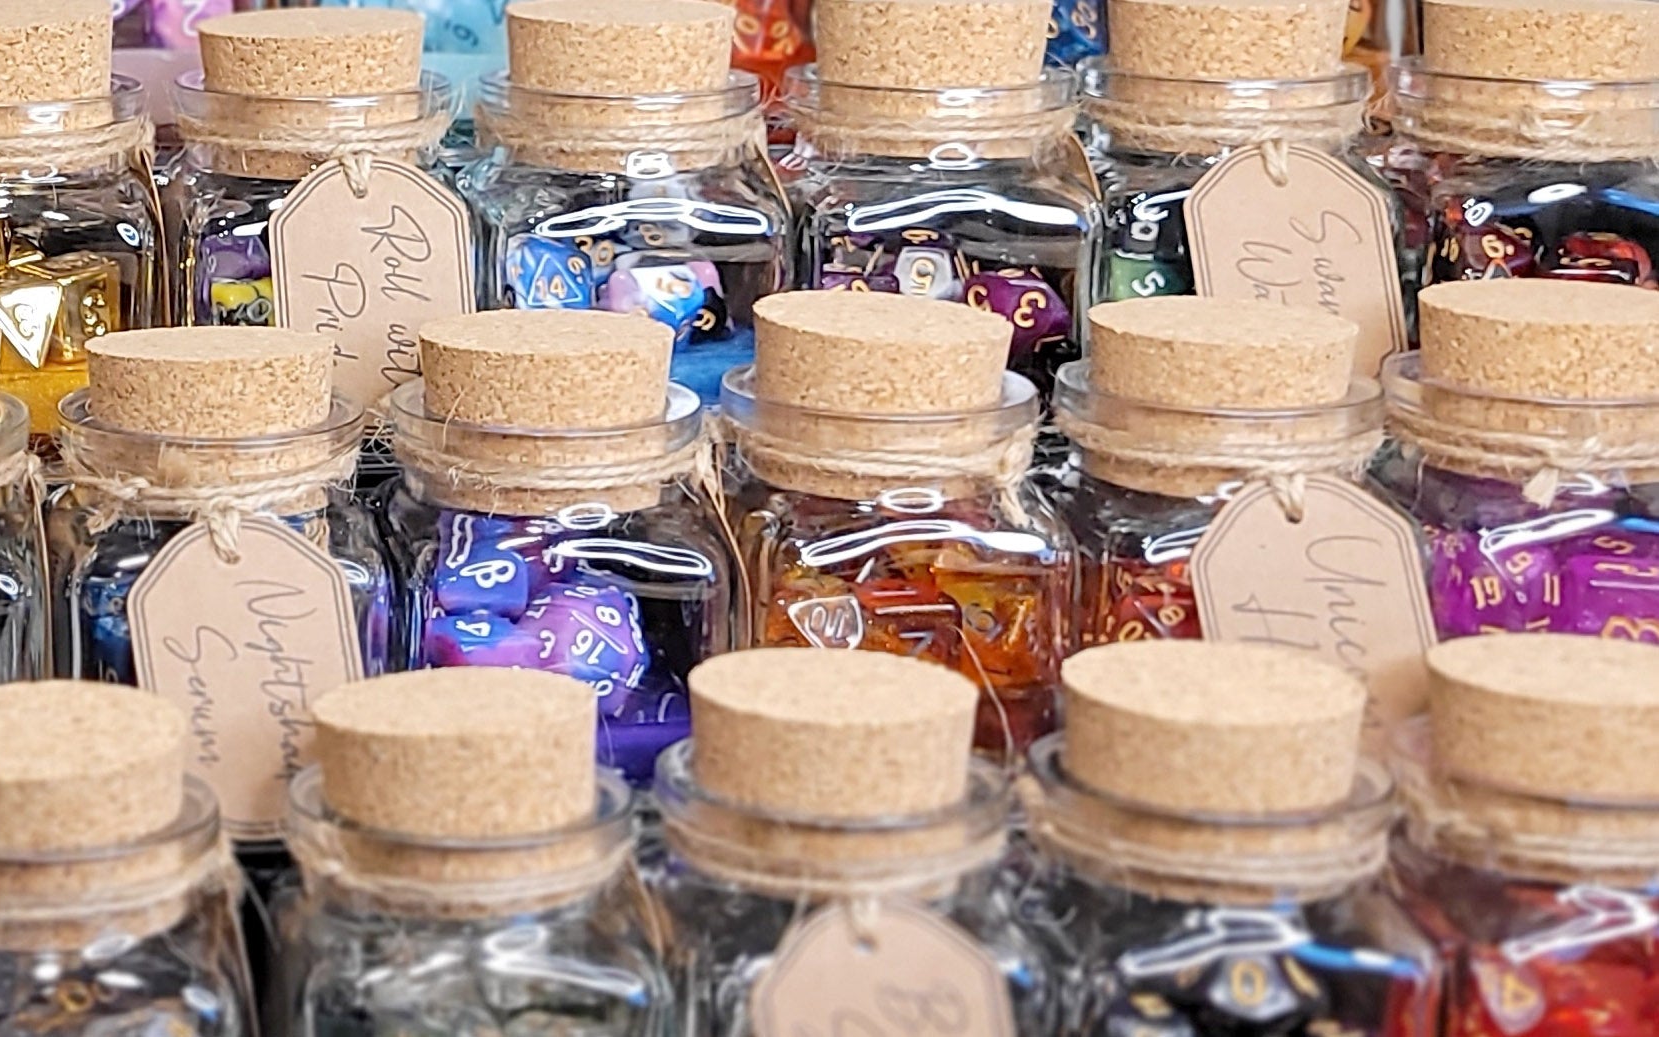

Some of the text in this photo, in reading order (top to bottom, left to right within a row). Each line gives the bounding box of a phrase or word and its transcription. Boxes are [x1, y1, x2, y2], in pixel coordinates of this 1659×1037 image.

[361, 205, 432, 391] Roll wit
[534, 274, 568, 300] 14
[1469, 574, 1504, 610] 19
[594, 604, 623, 627] 8
[163, 625, 239, 767] Serum
